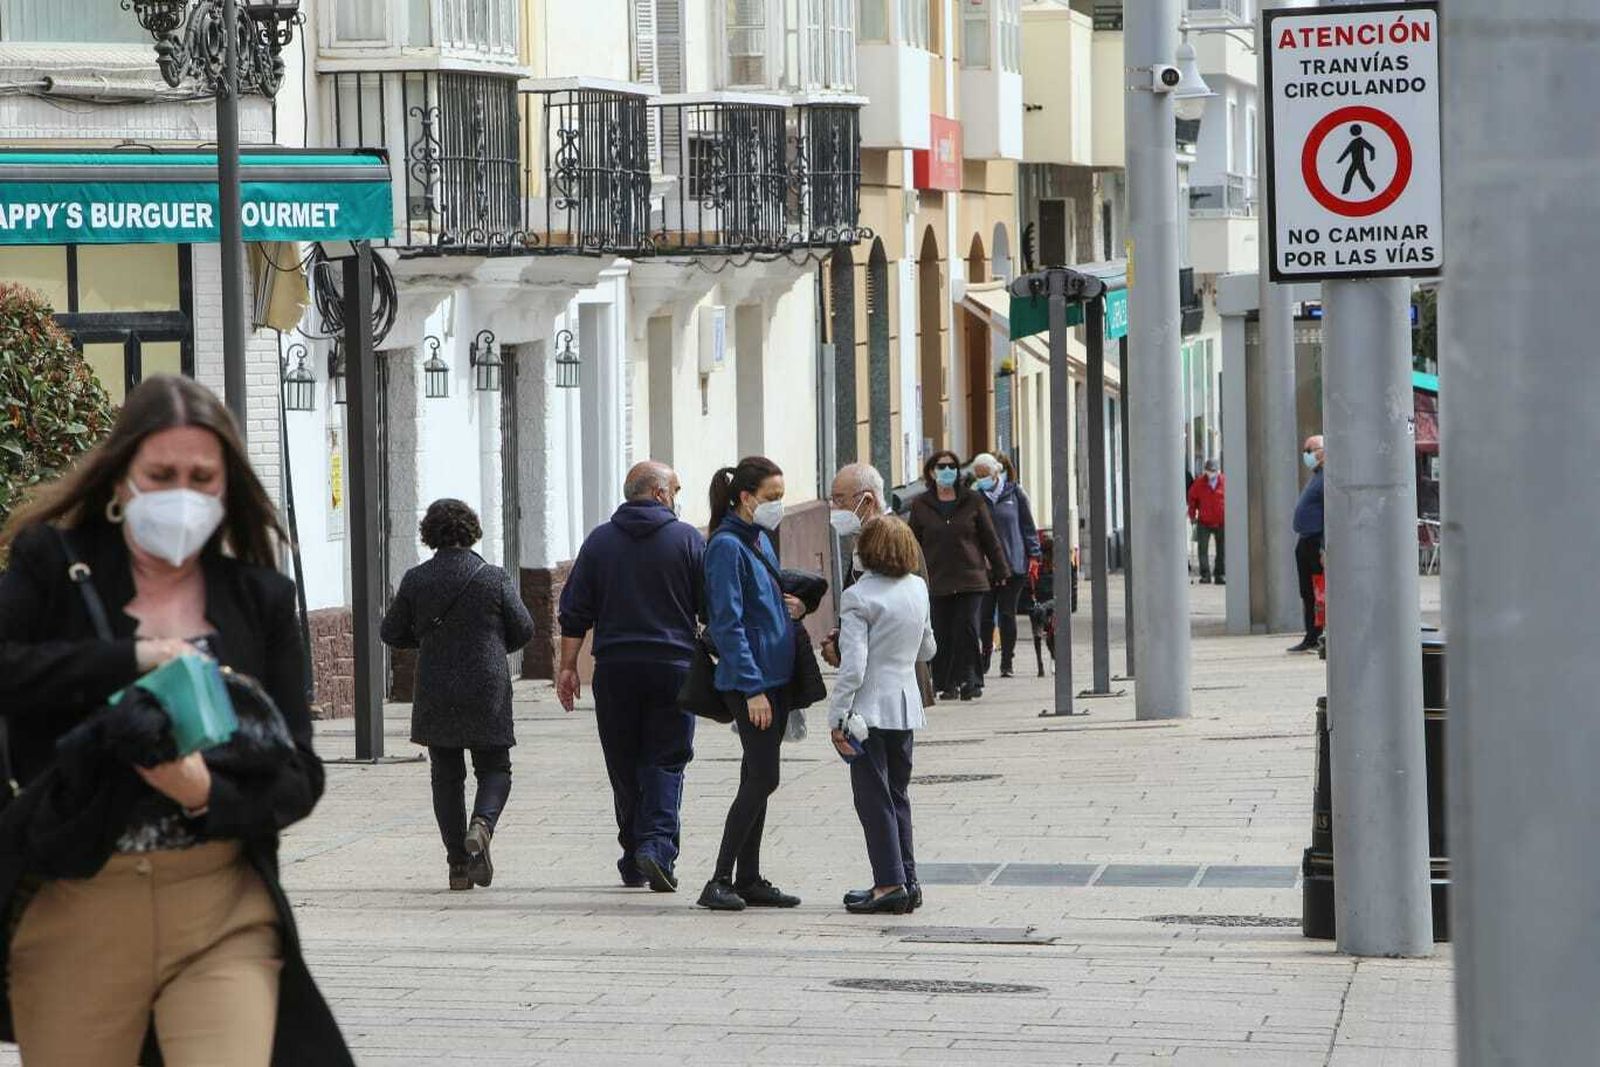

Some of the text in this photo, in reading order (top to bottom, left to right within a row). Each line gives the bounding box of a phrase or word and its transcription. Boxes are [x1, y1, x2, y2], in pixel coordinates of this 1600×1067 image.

[1278, 15, 1430, 49] ATENCIÓN
[1300, 51, 1409, 75] TRANVÍAS
[1284, 77, 1426, 98] CIRCULANDO
[91, 202, 214, 229] BURGUER
[241, 202, 339, 228] OURMET
[1288, 224, 1429, 245] NO CAMINAR
[1284, 242, 1435, 267] POR LAS VÍAS
